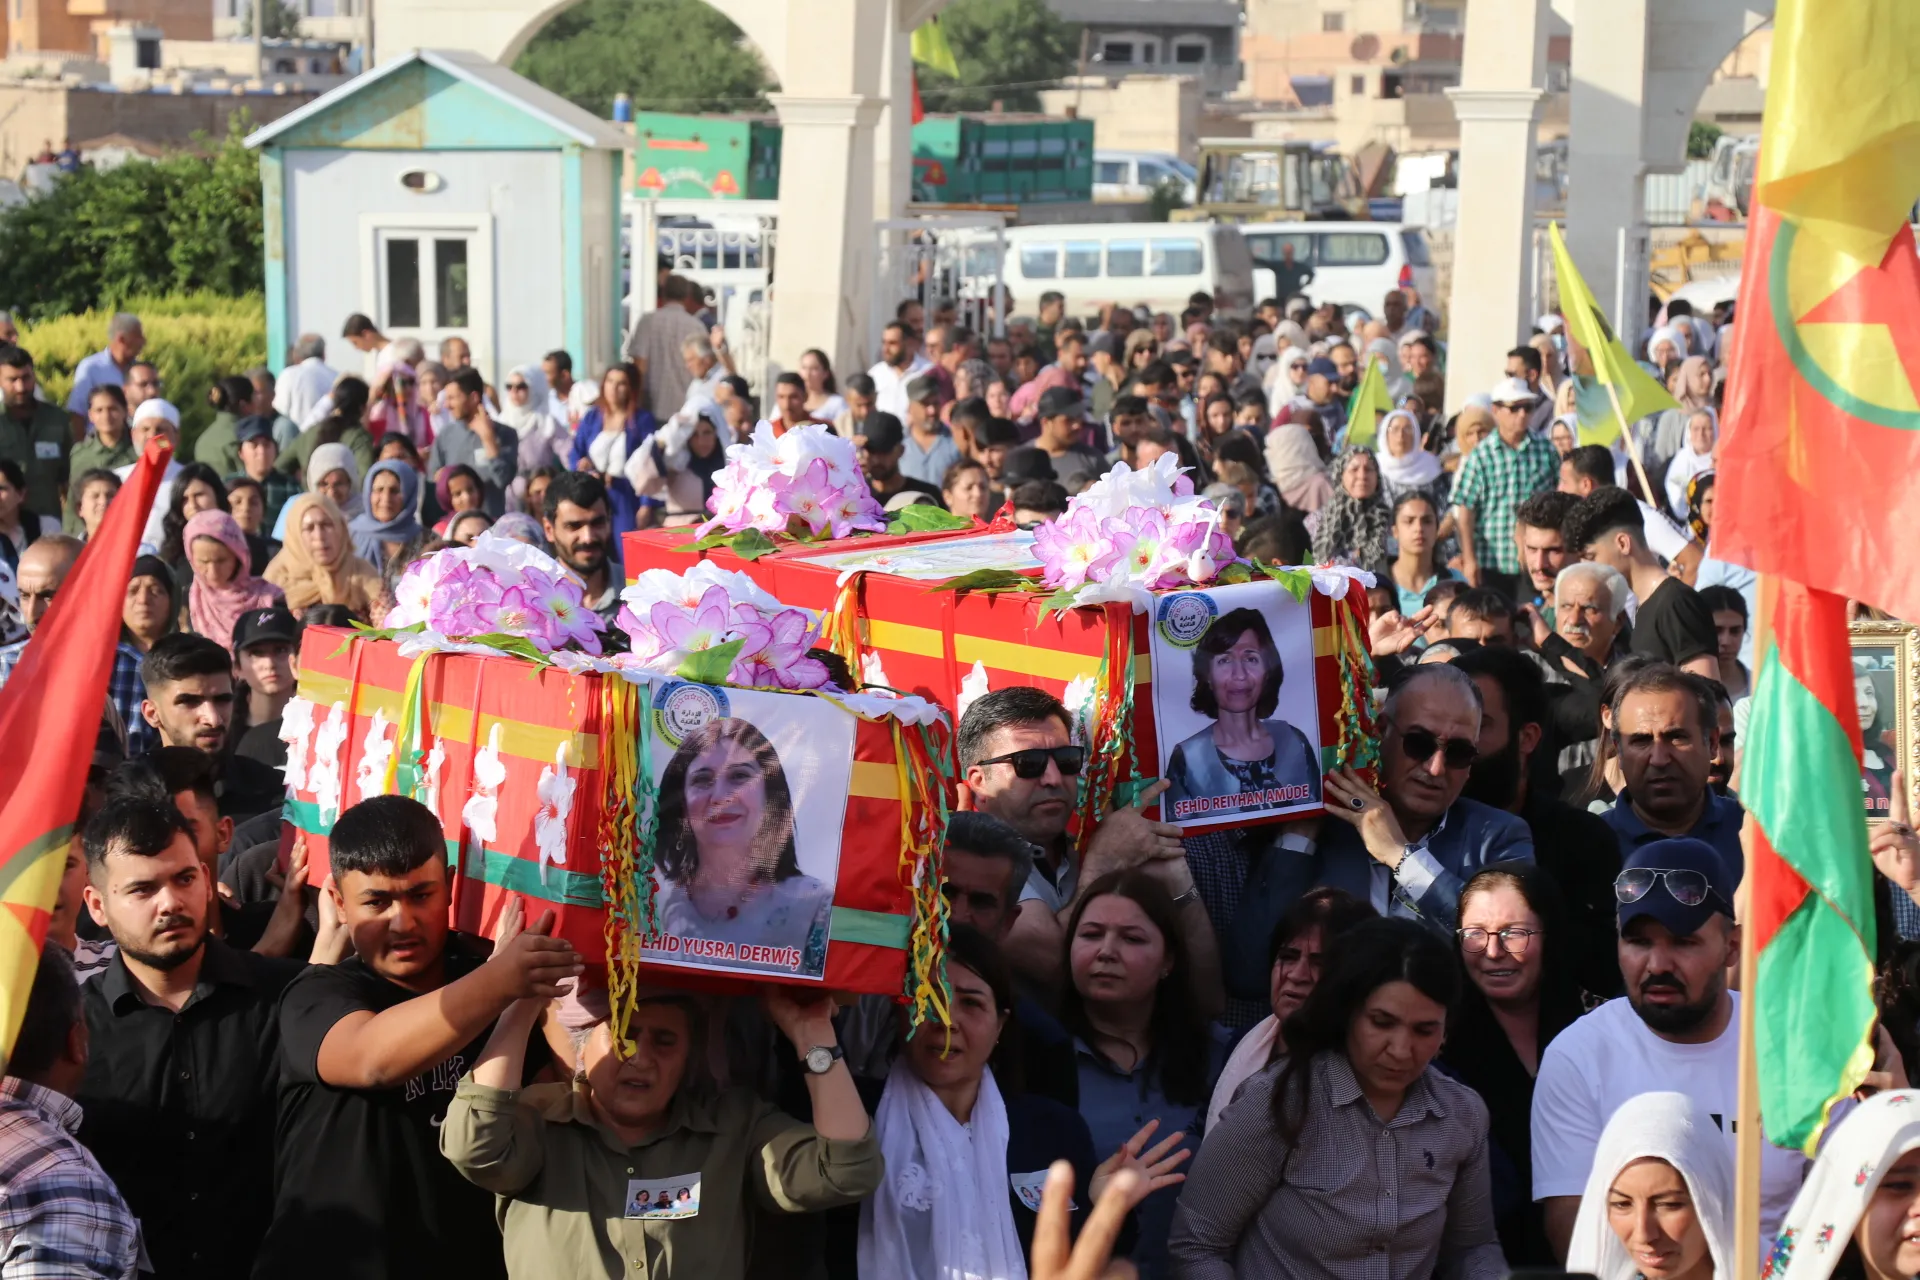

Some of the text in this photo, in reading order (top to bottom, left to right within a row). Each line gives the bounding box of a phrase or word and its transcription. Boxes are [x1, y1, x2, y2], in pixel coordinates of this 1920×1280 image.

[1175, 784, 1309, 817] ŞEHÎD REIYHAN AMÛDE
[634, 932, 802, 971] EHÎD YUSRA DERWÎŞ
[405, 1056, 464, 1102] NIK
